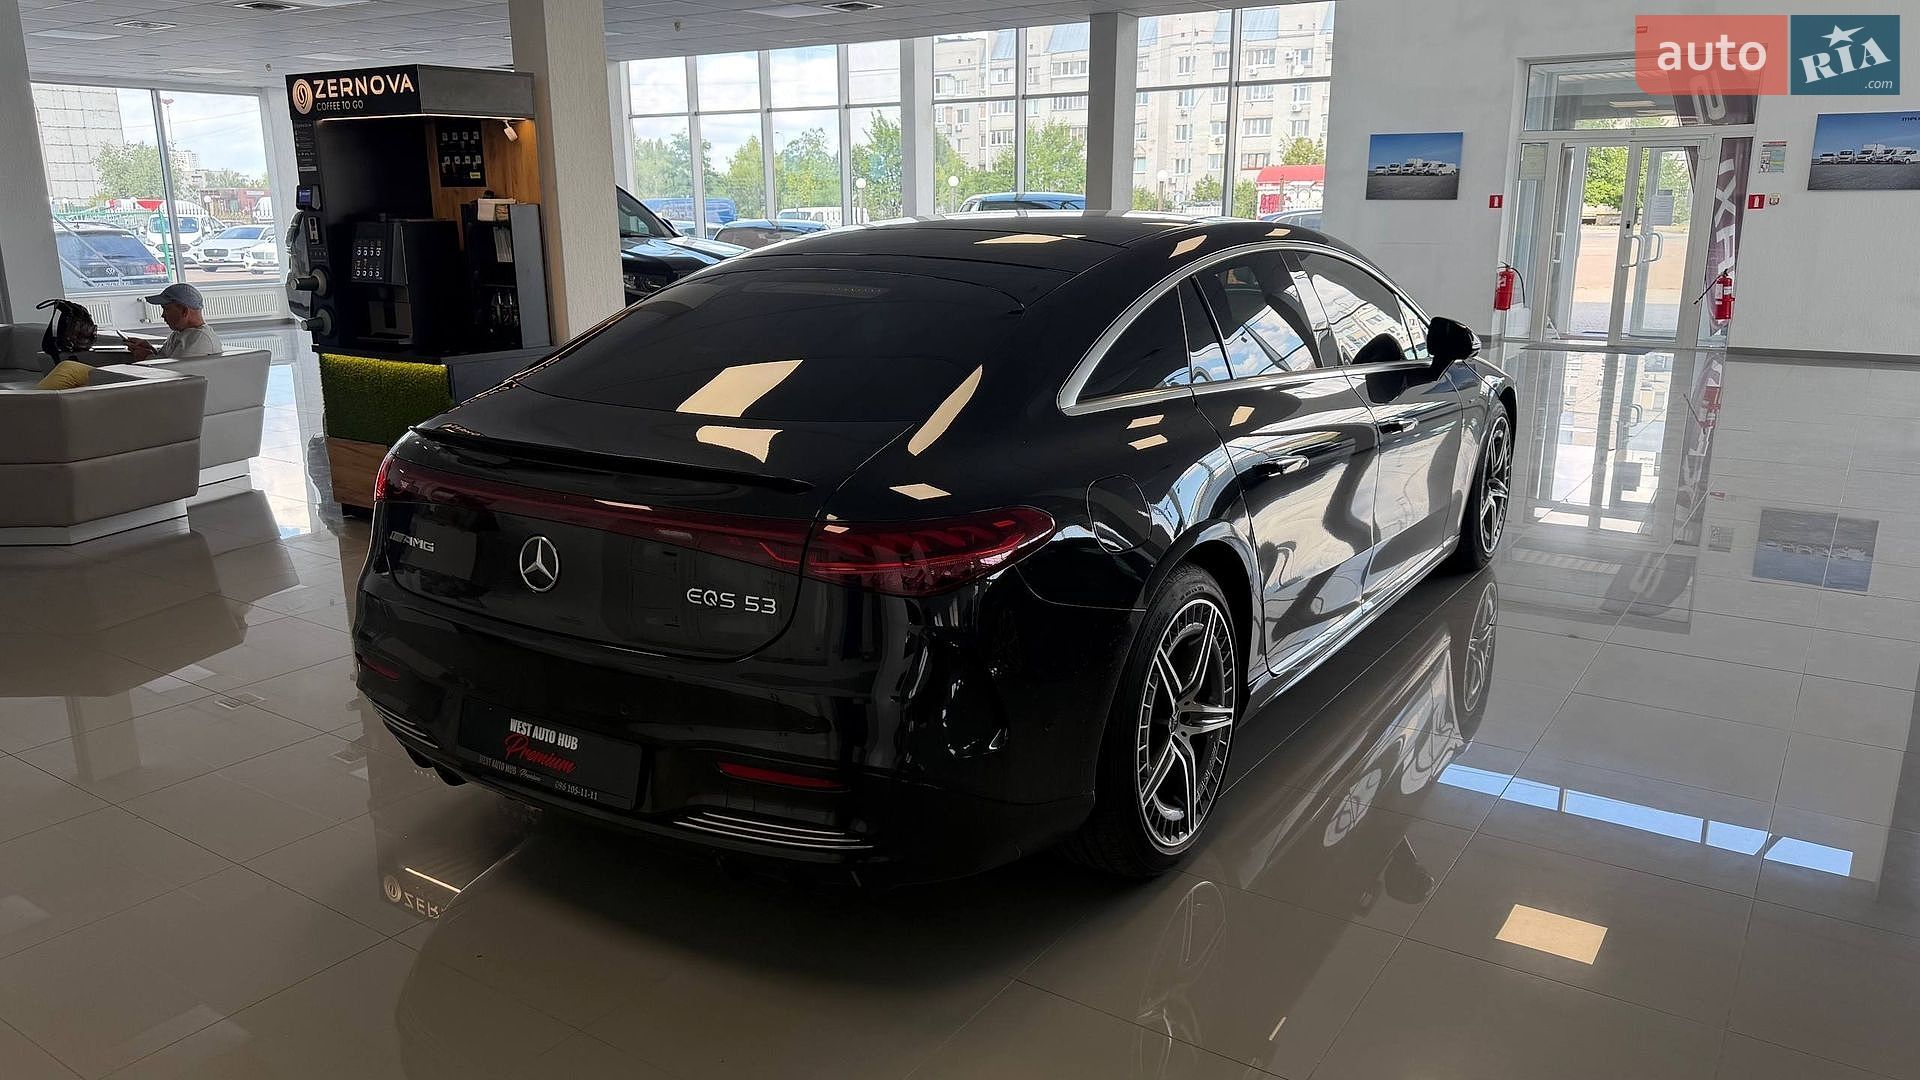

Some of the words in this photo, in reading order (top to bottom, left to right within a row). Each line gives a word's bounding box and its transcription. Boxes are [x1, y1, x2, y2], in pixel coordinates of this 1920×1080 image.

[313, 73, 415, 99] ZERNOVA
[316, 101, 341, 111] COFFEE
[342, 101, 350, 110] TO
[352, 100, 364, 109] GO
[403, 535, 435, 552] AMG
[686, 587, 735, 609] EQS
[745, 595, 777, 614] 53
[509, 718, 531, 737] WEST
[532, 726, 556, 744] AUTO
[557, 732, 579, 750] HUB
[503, 733, 577, 775] Premium
[492, 759, 505, 772] AUTO
[567, 784, 598, 800] 105-11-11
